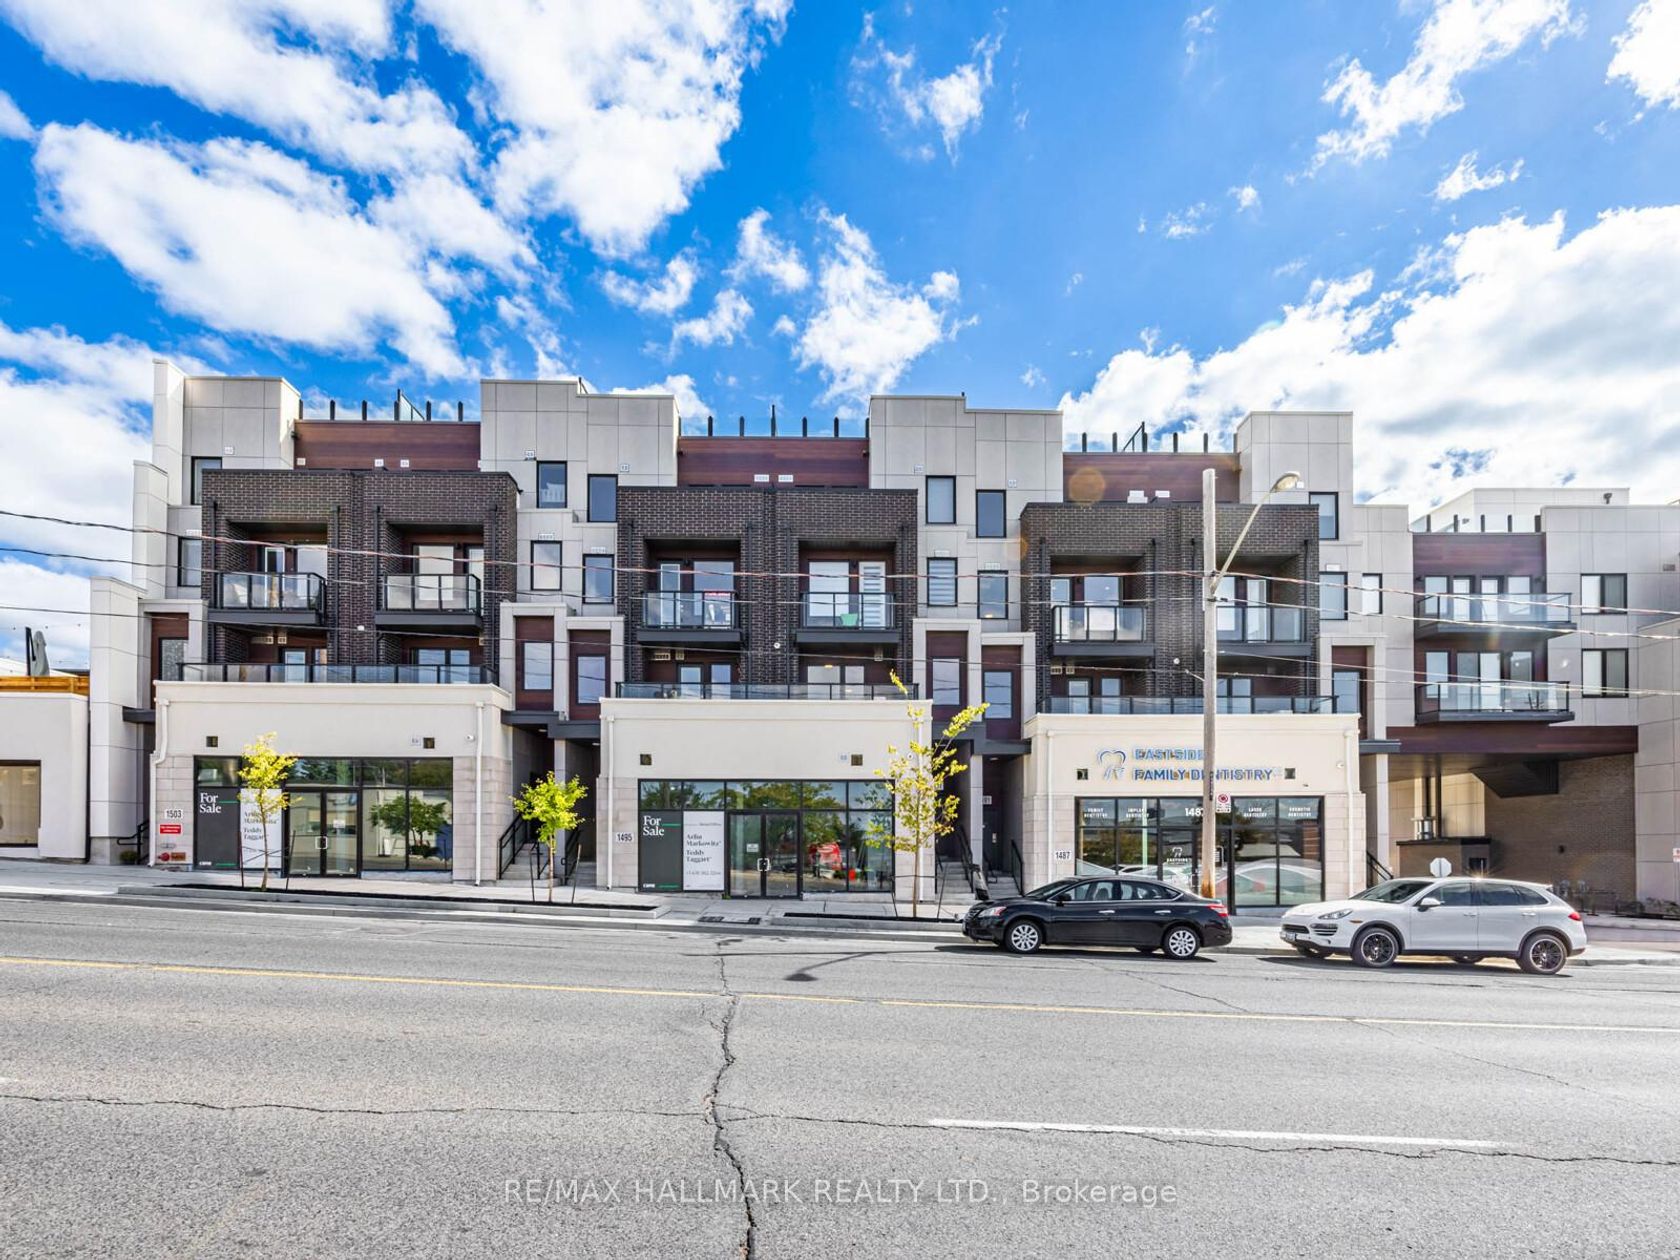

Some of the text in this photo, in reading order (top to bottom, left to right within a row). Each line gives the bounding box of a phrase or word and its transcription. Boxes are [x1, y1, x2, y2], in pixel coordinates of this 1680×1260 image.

[1134, 749, 1204, 761] EASTSIDE
[1134, 769, 1185, 781] FAMILY
[200, 793, 218, 803] For
[200, 804, 221, 813] Sale
[166, 809, 182, 819] 1503
[643, 815, 661, 826] For
[643, 827, 664, 836] Sale
[617, 833, 632, 842] 1495
[1056, 851, 1071, 860] 1487
